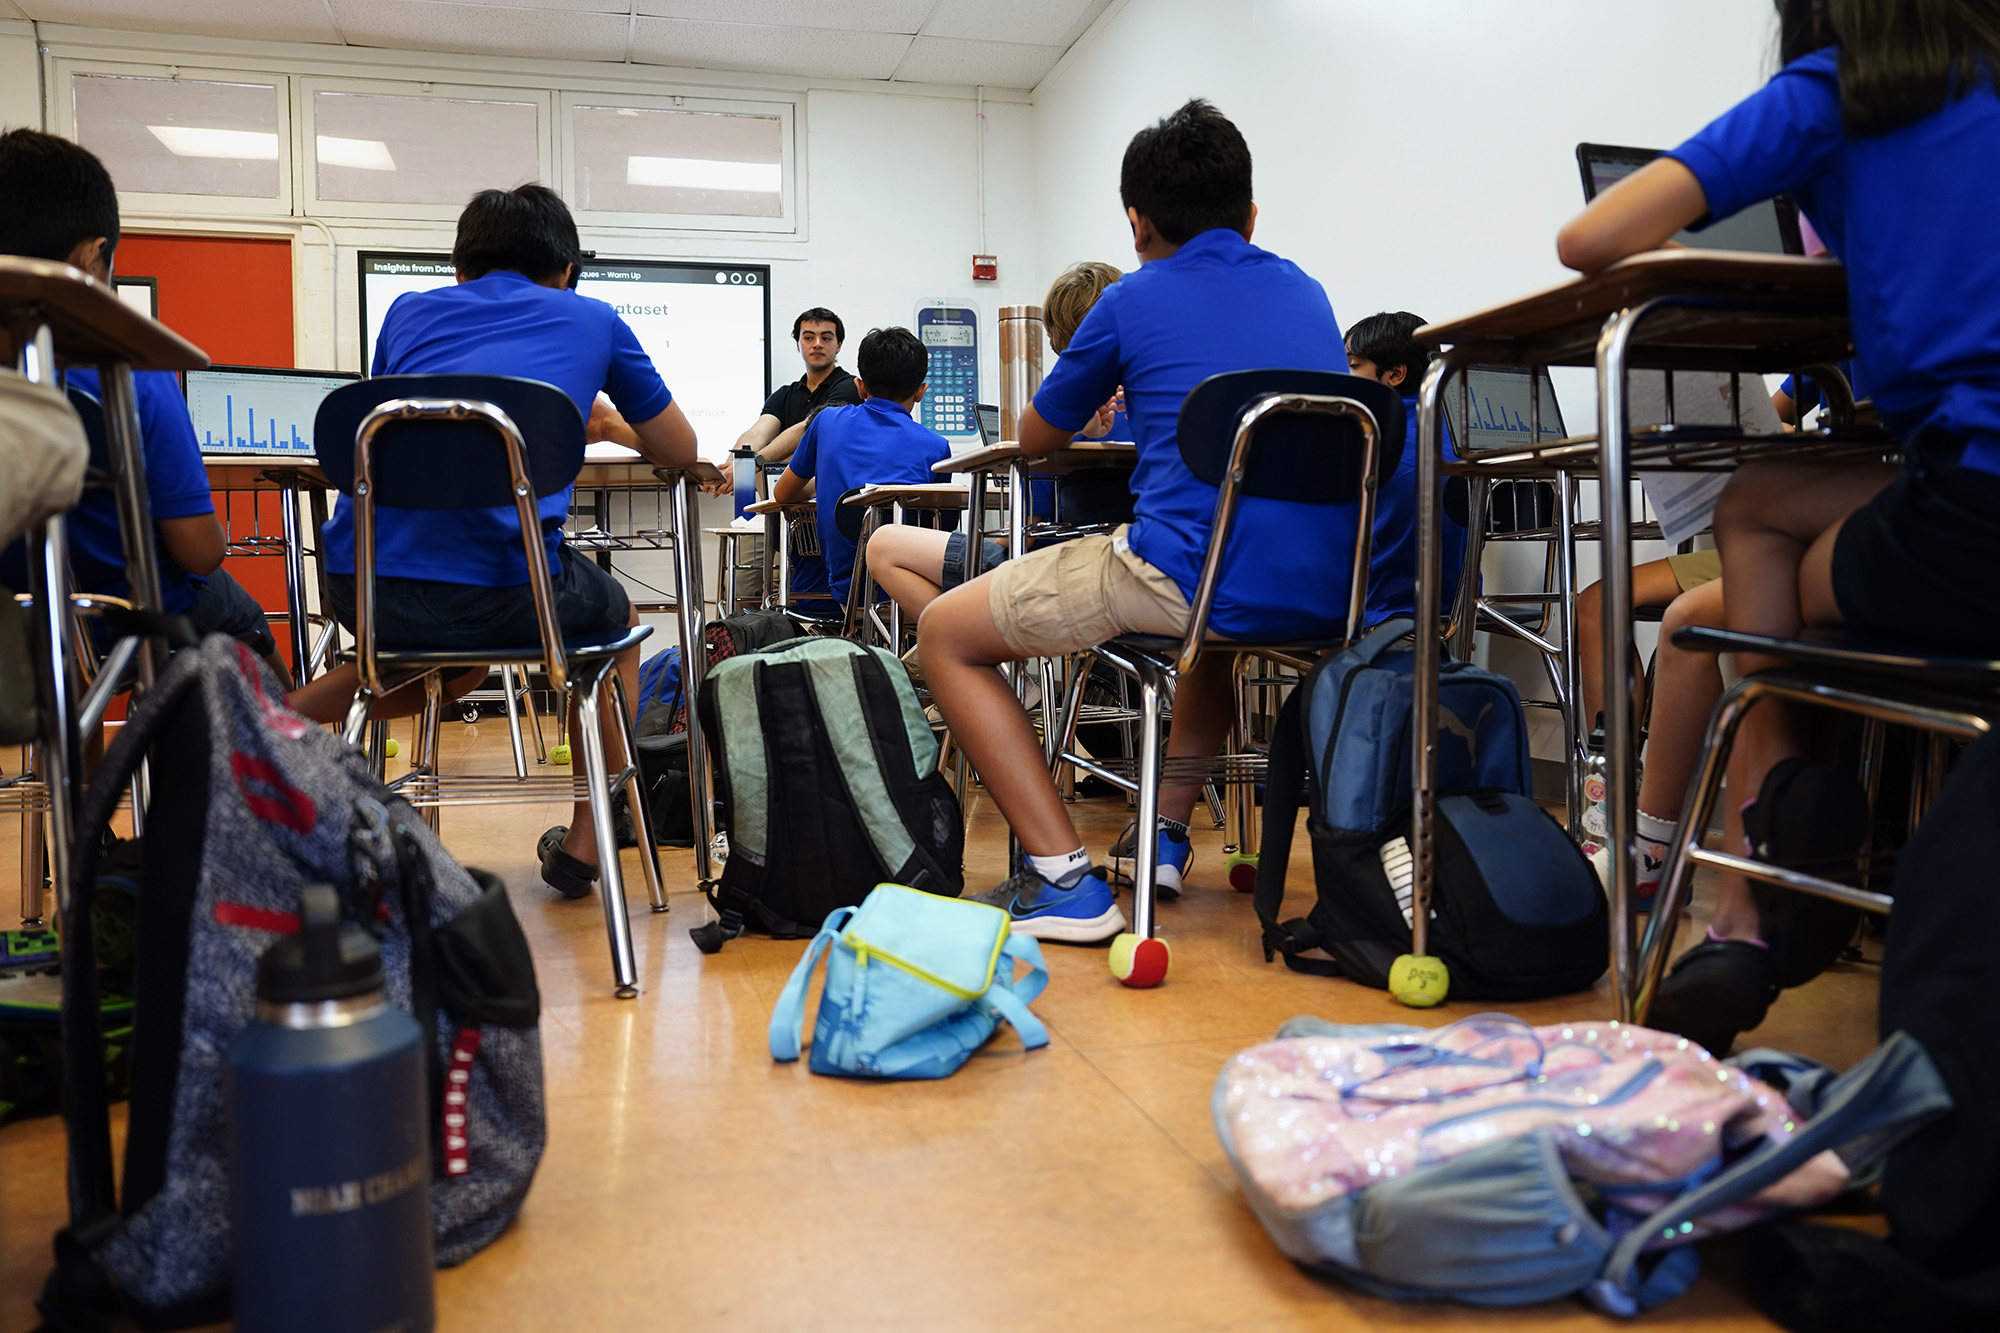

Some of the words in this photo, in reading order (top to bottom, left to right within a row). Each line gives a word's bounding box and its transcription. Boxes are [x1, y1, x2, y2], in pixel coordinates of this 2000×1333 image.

[374, 263, 411, 273] Insights
[412, 264, 434, 273] from
[581, 271, 600, 279] ques
[607, 271, 630, 279] Warm
[631, 272, 641, 280] Up
[609, 303, 668, 315] ataset
[1158, 816, 1188, 833] PUMA
